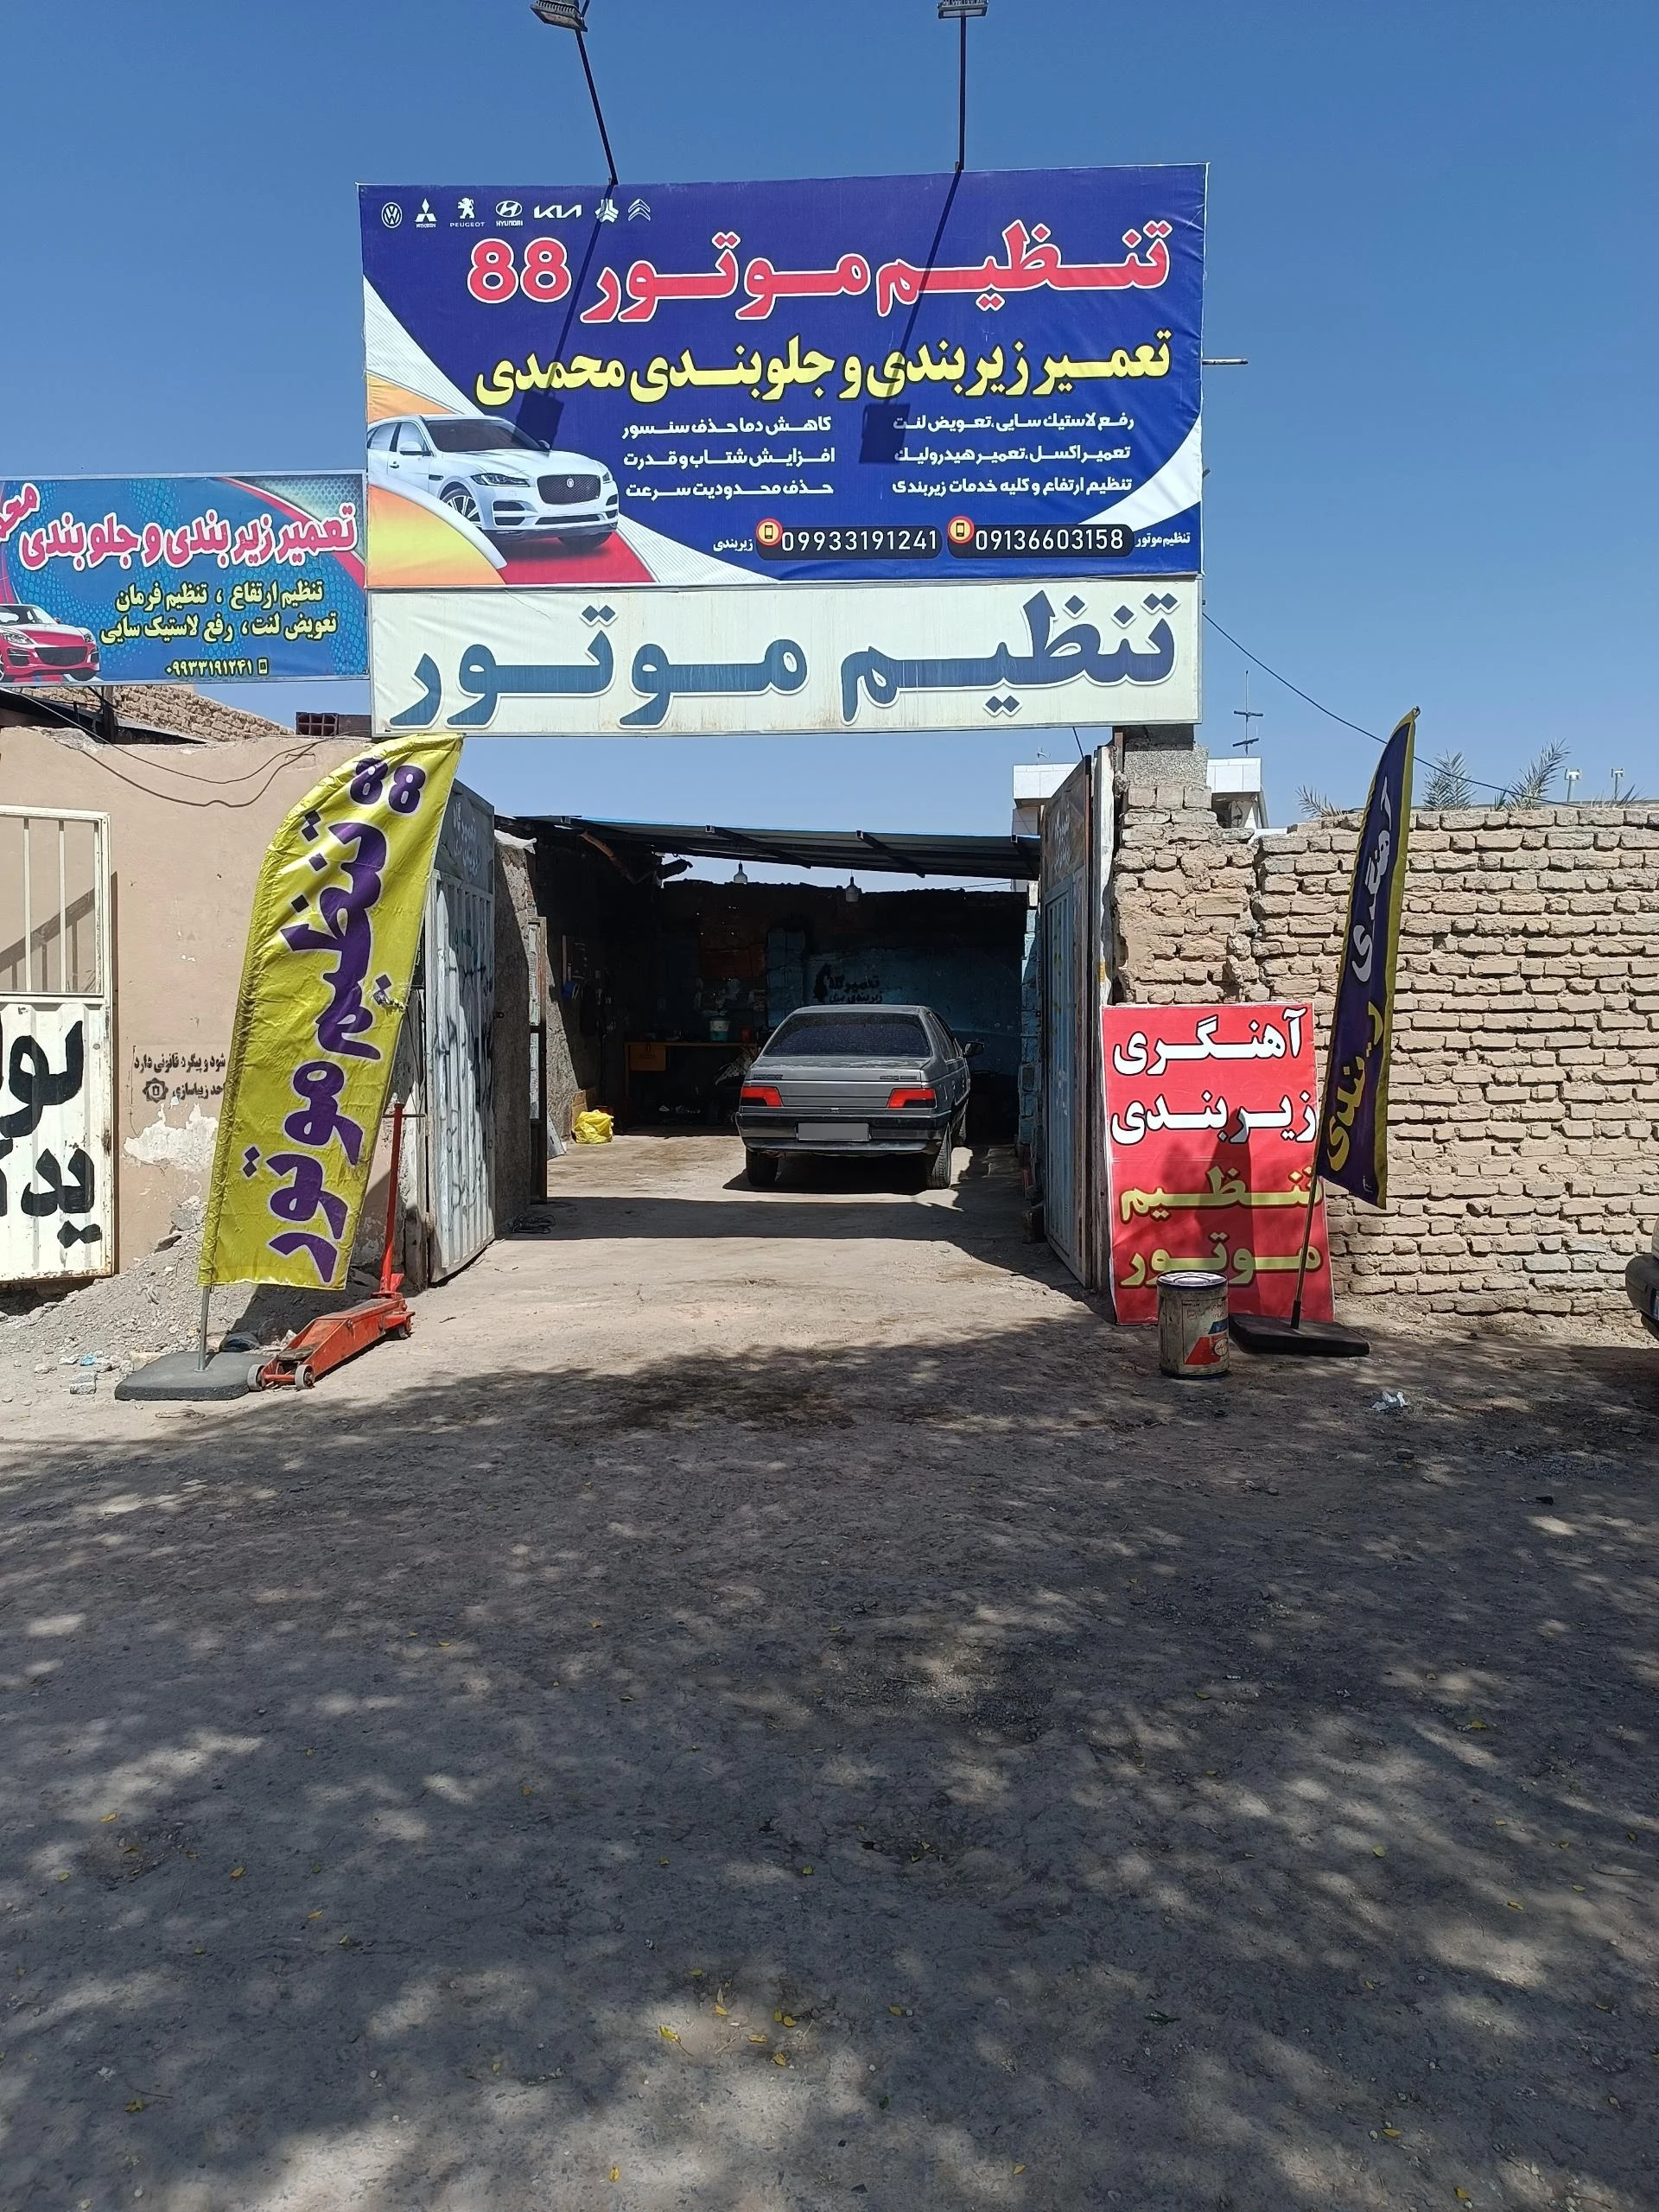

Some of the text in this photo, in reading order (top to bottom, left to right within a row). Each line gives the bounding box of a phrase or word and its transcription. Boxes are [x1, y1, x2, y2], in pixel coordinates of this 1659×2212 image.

[467, 219, 1173, 322] تنظیم موتور 88
[838, 355, 861, 399] و
[1033, 328, 1172, 397] تعمیر
[474, 351, 626, 405] محمدی
[622, 416, 831, 439] کاهش دما حذف سنسور
[893, 415, 926, 429] لنت
[1097, 412, 1135, 431] رفع
[623, 448, 836, 470] افزایش شتاب و قدرت
[1080, 446, 1131, 463] تعمیر
[626, 480, 835, 501] حذف محدودیت سرعت
[892, 477, 1133, 497] تنظیم ارتفاع و کلیه خدمات زیربندی
[142, 523, 163, 567] و
[276, 503, 357, 565] تعمیر
[781, 530, 938, 551] 09933191241
[975, 529, 1191, 551] تنظیم موتور 09136603158
[116, 581, 162, 612] فرمان
[165, 582, 207, 610] تنظیم
[230, 580, 277, 610] ارتفاع
[281, 580, 324, 608] تنظیم
[99, 615, 140, 644] سایی
[144, 613, 200, 641] لاستیک
[203, 613, 233, 642] رفع
[284, 612, 339, 640] تعویض
[165, 658, 252, 676] ۰۹۹۳۳۱۹۱۲۴۱
[390, 590, 1180, 729] تنظیم موتور
[349, 757, 427, 814] 88
[241, 808, 396, 1285] تنظیم موتور
[1113, 1007, 1306, 1075] آهنگری
[134, 1053, 152, 1073] دارد
[1119, 1166, 1324, 1224] تنظیم
[1120, 1231, 1323, 1287] موتور
